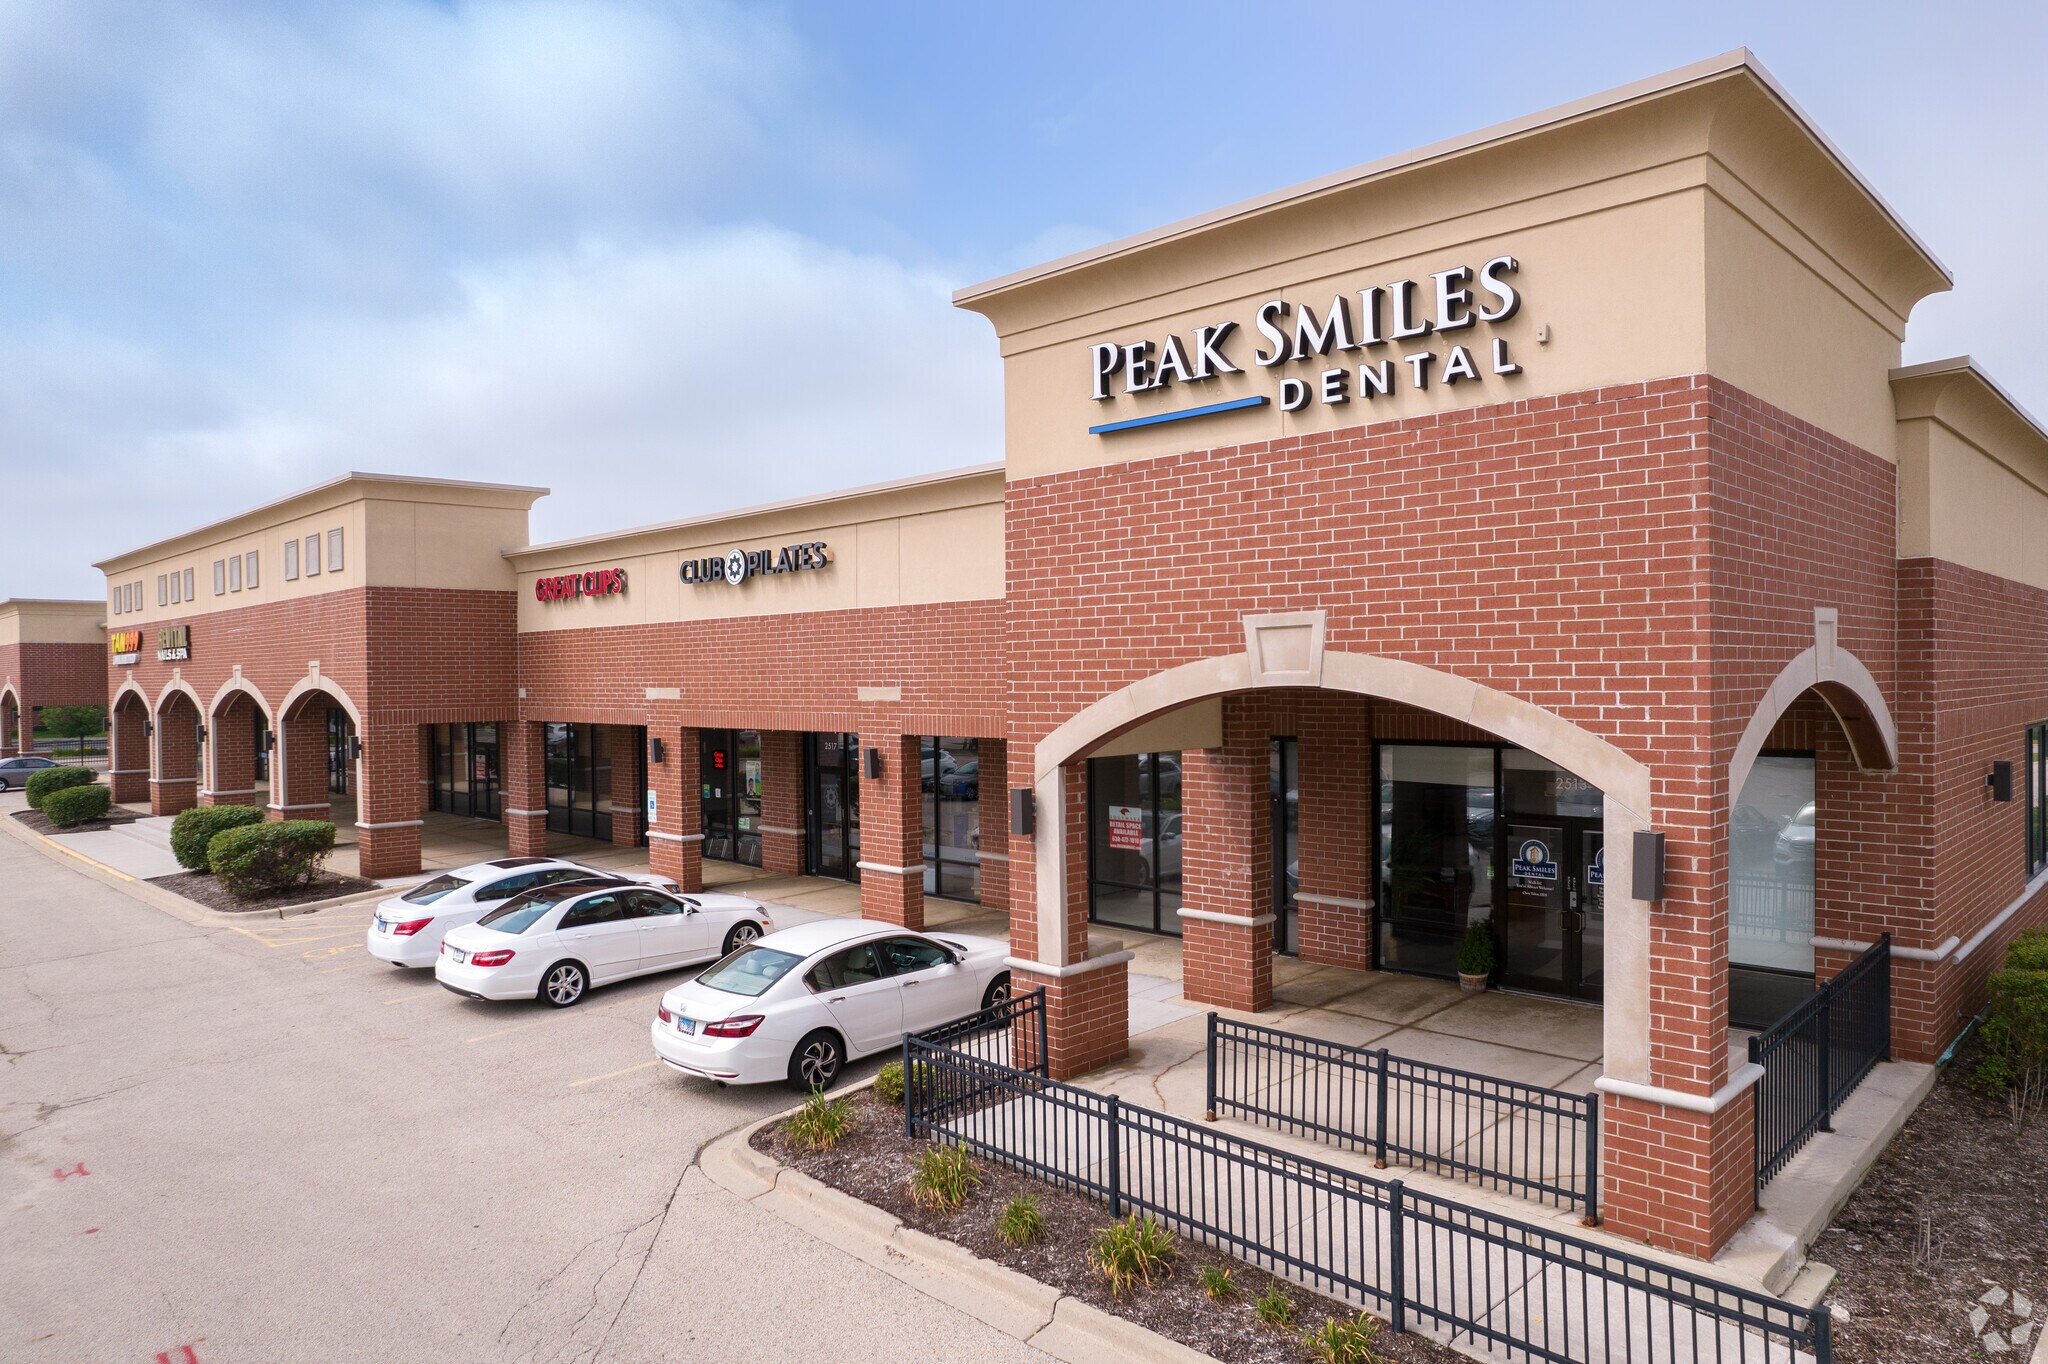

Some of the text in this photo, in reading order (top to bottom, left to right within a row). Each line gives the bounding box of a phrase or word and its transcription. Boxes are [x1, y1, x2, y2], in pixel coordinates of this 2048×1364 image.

[1087, 255, 1520, 401] PEAK SMILES
[1279, 337, 1523, 412] DENTAL
[680, 542, 828, 585] CLUB PILATES
[535, 567, 626, 602] GREAT CLIPS
[824, 742, 838, 750] 2517
[1110, 821, 1141, 830] RETAIL SPACE
[1113, 828, 1139, 836] AVAILABLE
[1515, 864, 1555, 874] PEAK SMILES
[1590, 871, 1604, 879] PEA
